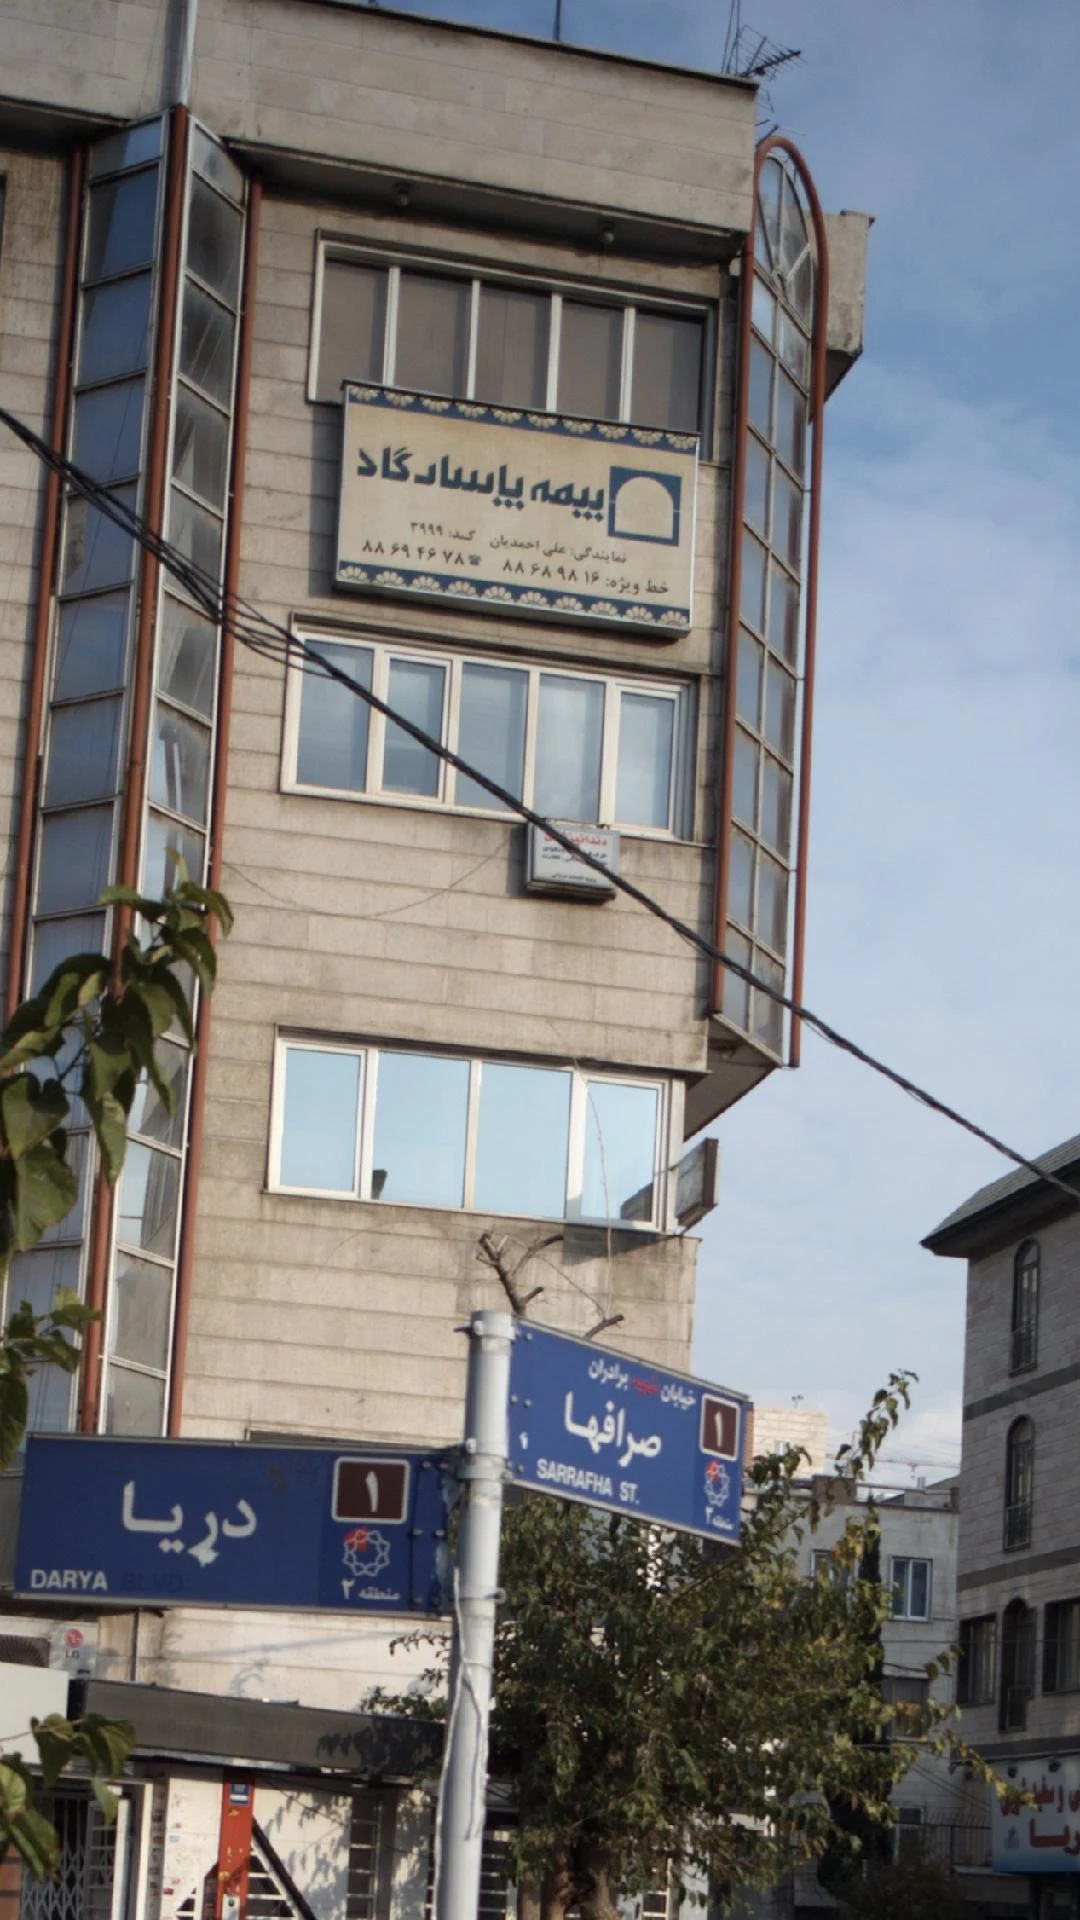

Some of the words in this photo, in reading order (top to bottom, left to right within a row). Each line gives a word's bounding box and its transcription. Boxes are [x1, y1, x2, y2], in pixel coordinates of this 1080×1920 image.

[357, 447, 524, 511] پاسارگاد
[530, 478, 605, 522] بیمه
[543, 542, 567, 557] علی
[646, 577, 668, 594] خط
[588, 1358, 630, 1391] برادران
[661, 1384, 696, 1410] خیابان
[564, 1390, 662, 1468] صرافها
[365, 1471, 379, 1513] ۱
[537, 1458, 613, 1497] SARRAFHA
[619, 1481, 640, 1504] ST.
[123, 1480, 257, 1568] دریا
[31, 1569, 108, 1591] DARYA
